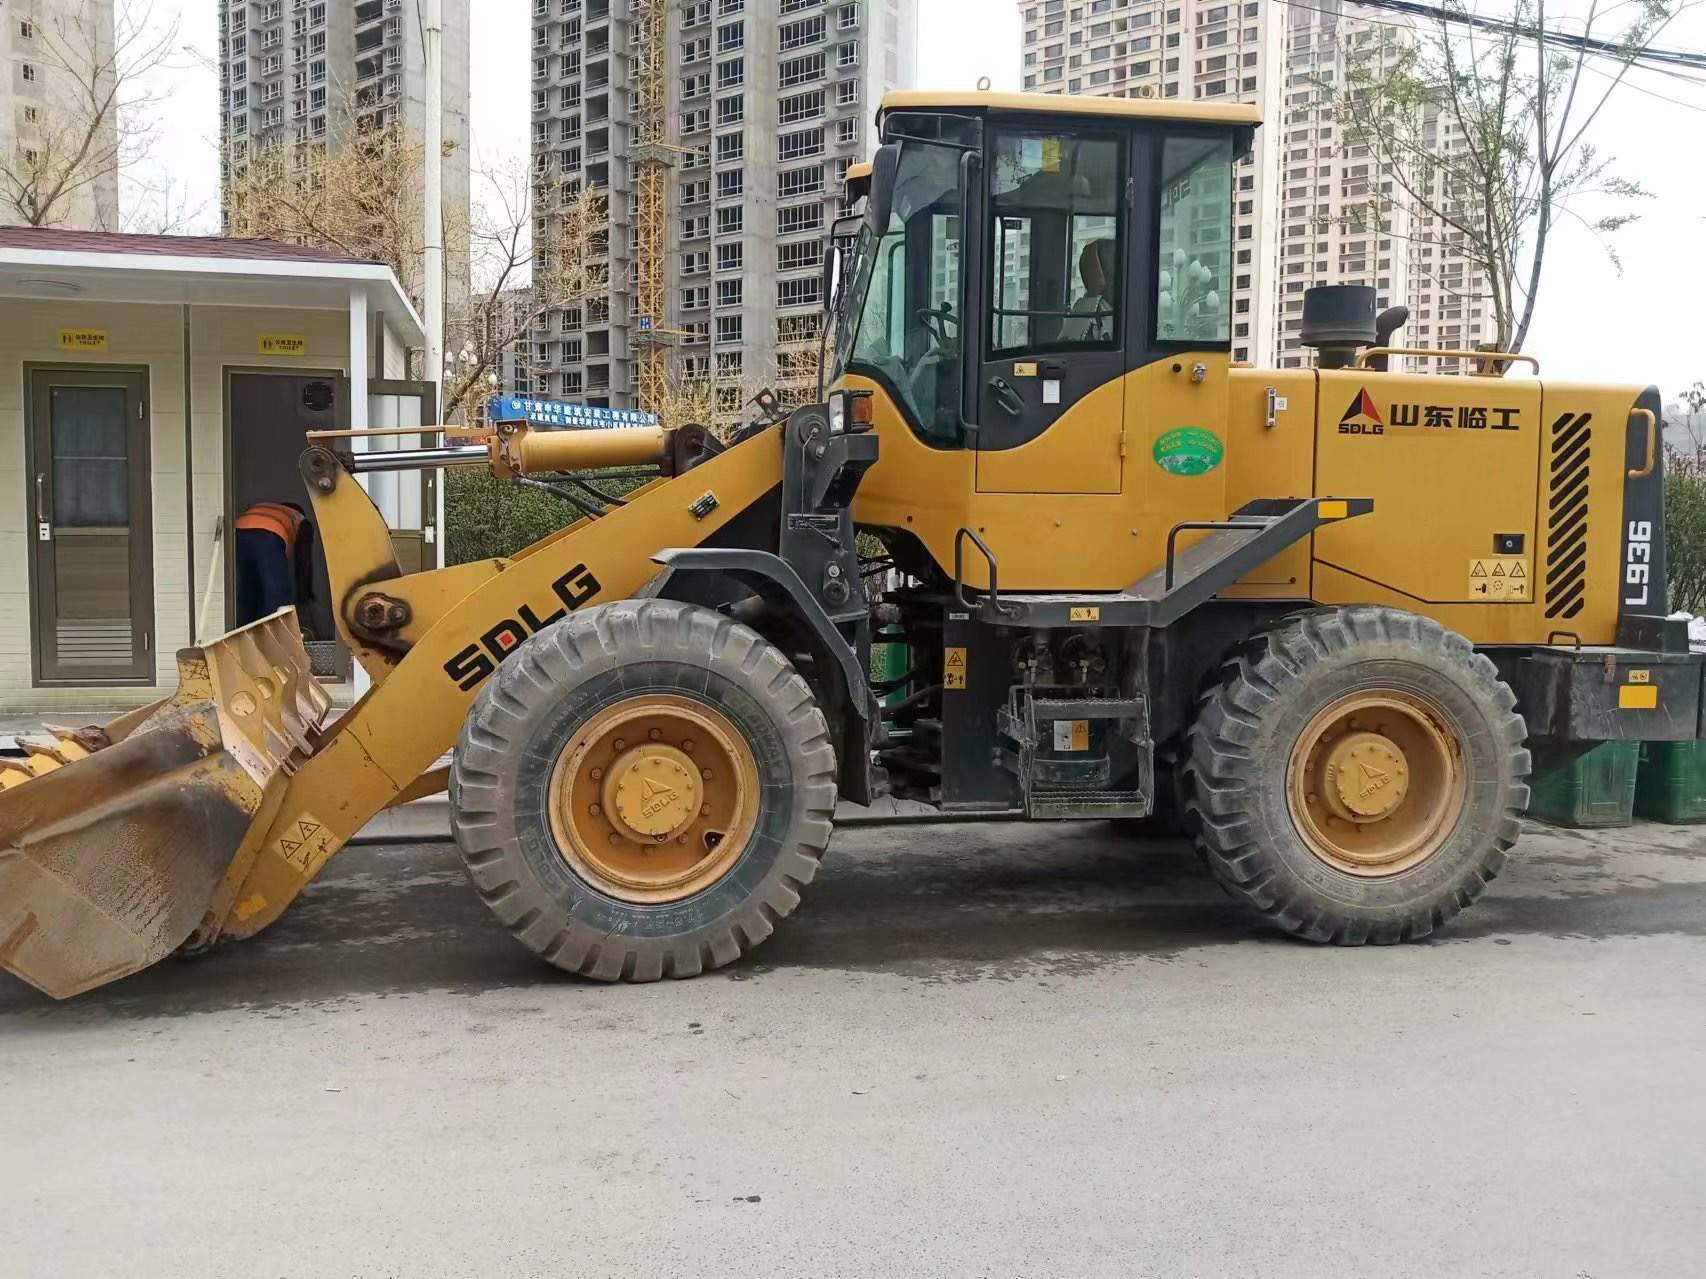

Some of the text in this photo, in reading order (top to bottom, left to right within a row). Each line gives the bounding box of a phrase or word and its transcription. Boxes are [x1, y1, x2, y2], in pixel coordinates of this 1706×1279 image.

[1338, 423, 1384, 435] SDLG
[1390, 404, 1520, 431] 山东临工
[1625, 520, 1652, 606] L936
[443, 563, 602, 692] SDLG
[1359, 774, 1392, 801] SDLG
[641, 791, 680, 819] SDLG
